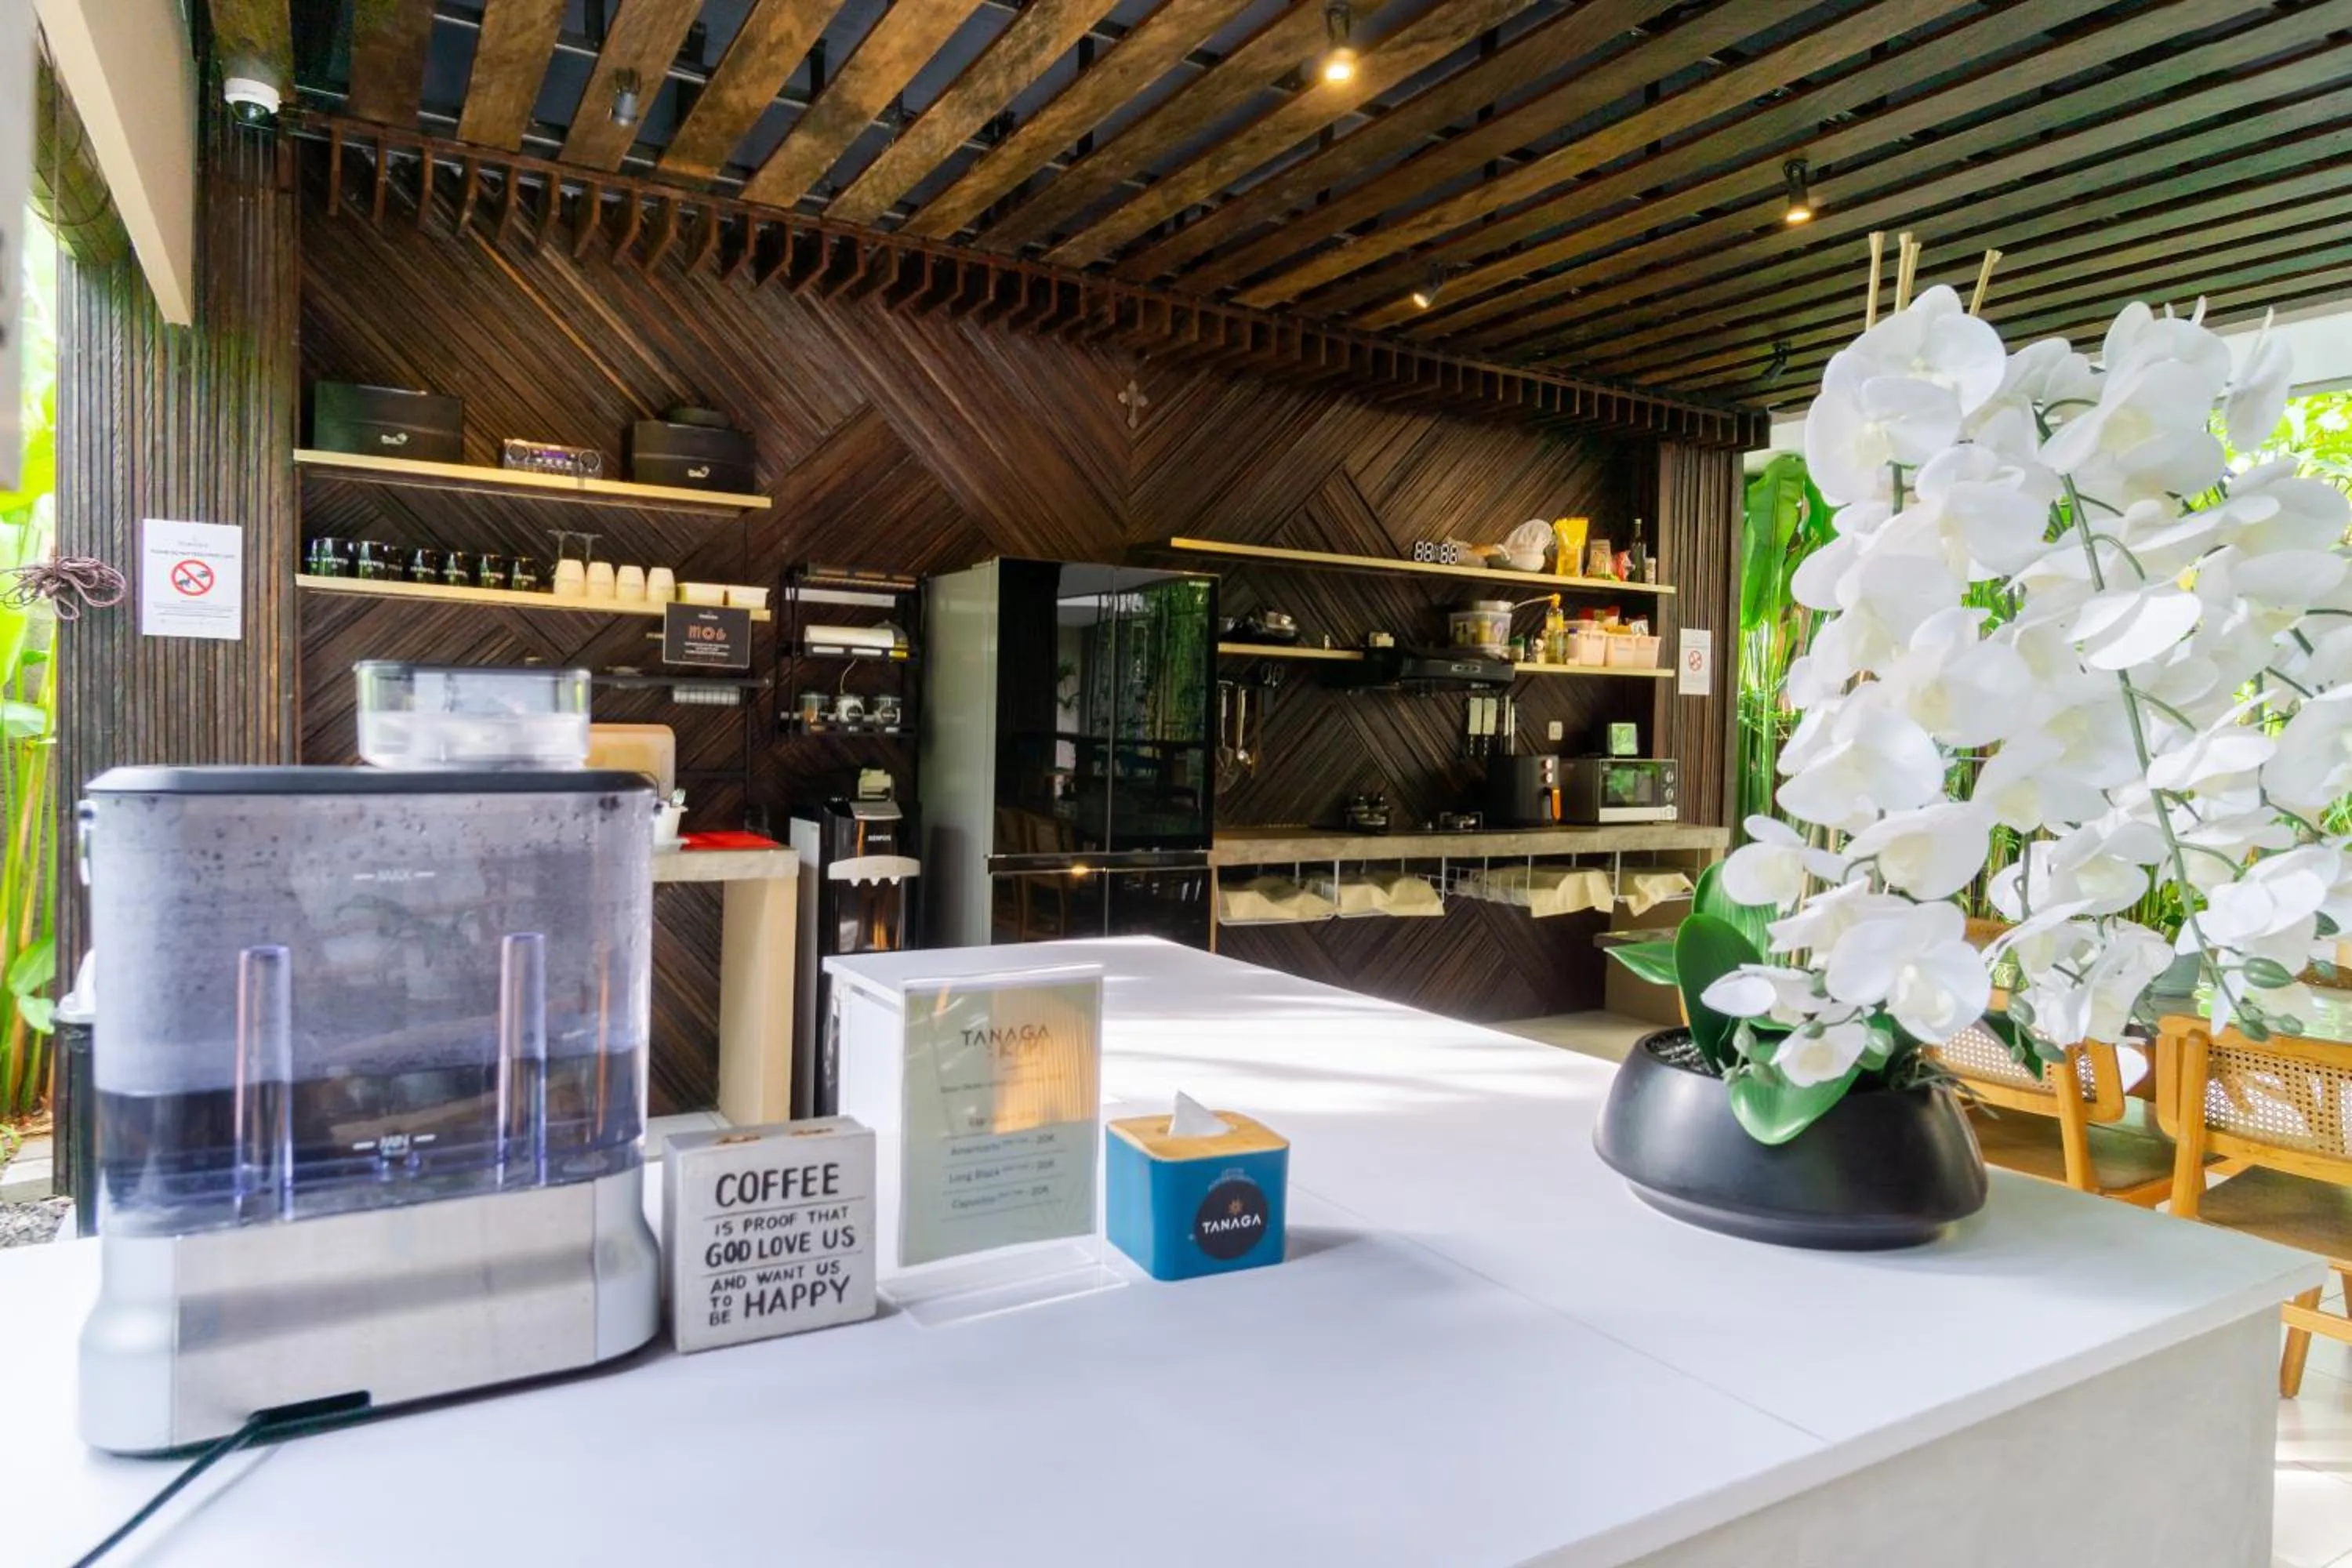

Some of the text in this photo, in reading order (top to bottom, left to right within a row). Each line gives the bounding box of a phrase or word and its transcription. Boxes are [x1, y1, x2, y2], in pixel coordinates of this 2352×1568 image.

[960, 1024, 1051, 1046] TANAGA
[714, 1163, 840, 1208] COFFEE
[714, 1205, 850, 1236] IS PROOF THAT
[1202, 1213, 1262, 1235] TANAGA
[704, 1225, 856, 1269] GOD LOVE US
[709, 1259, 841, 1294] AND WANT US
[709, 1274, 851, 1327] BE HAPPY
[709, 1294, 733, 1310] TO
